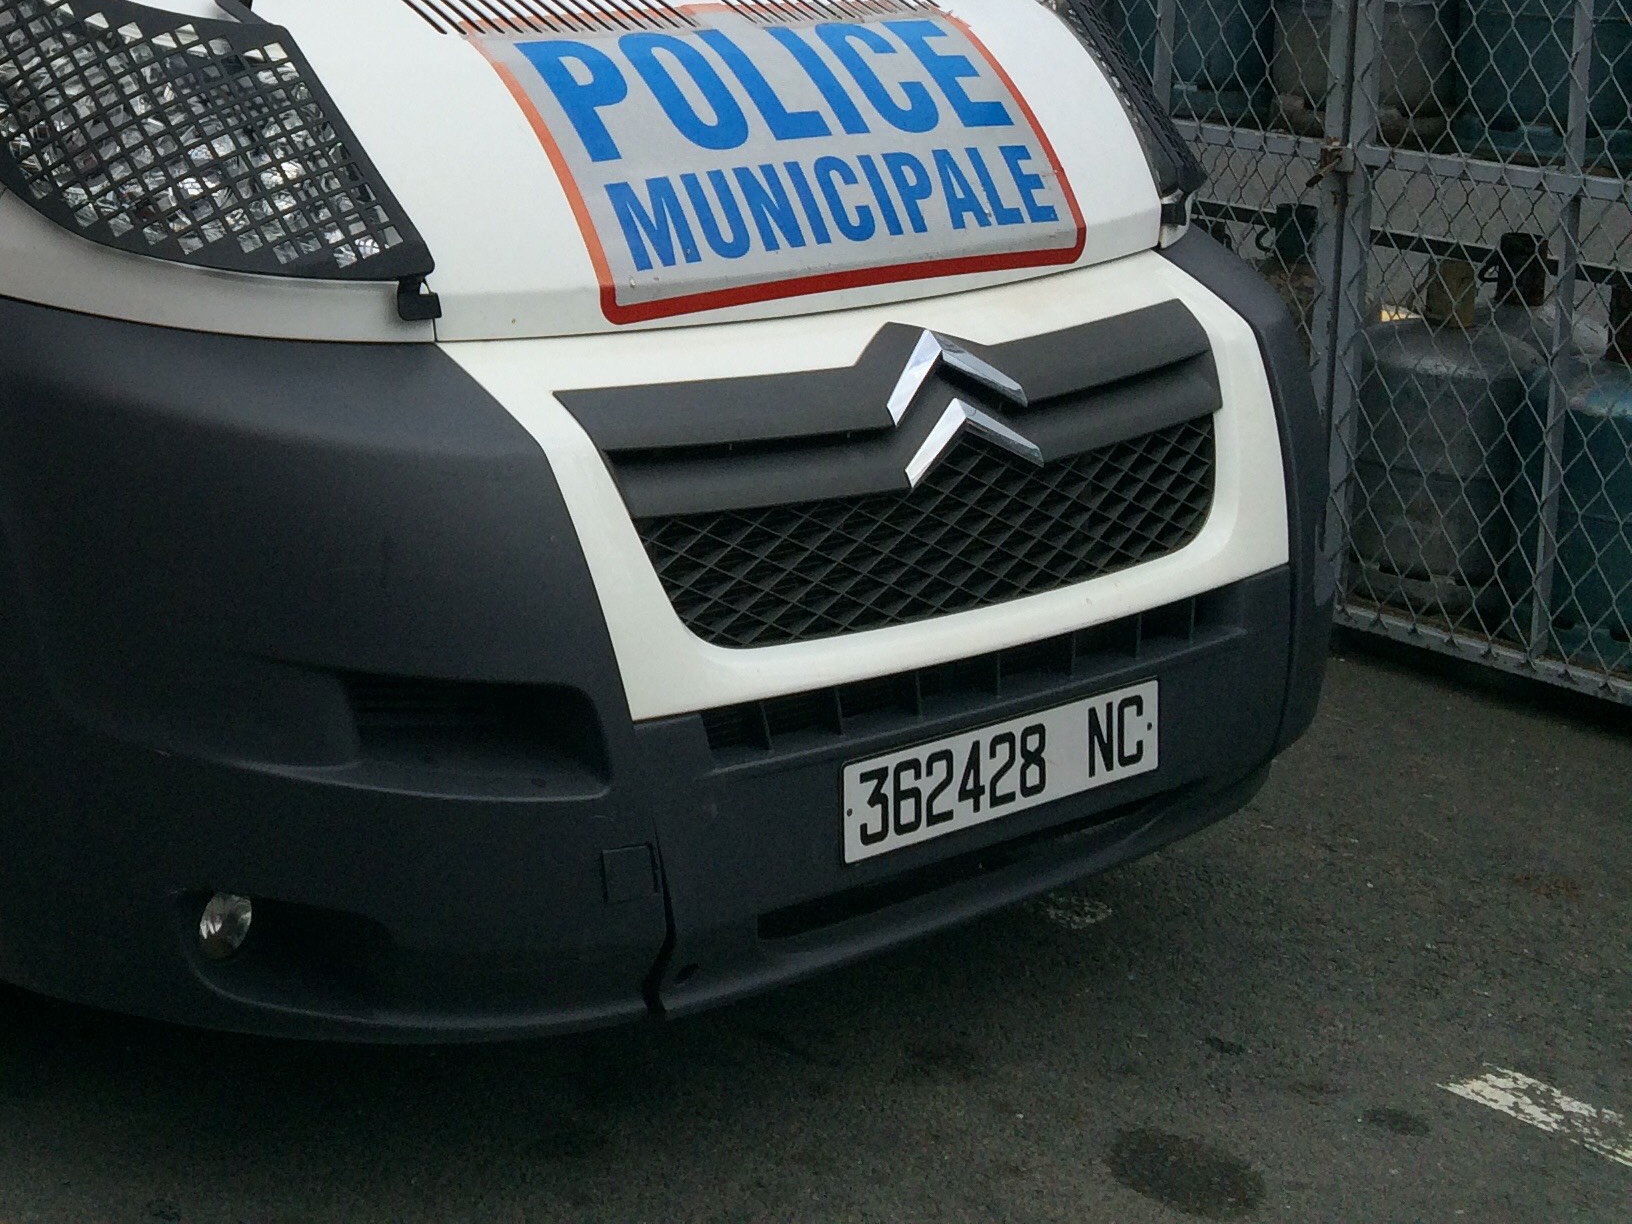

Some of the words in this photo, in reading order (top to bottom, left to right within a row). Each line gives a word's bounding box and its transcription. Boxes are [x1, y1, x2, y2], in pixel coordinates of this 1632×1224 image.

[513, 20, 1014, 163] POLICE
[604, 144, 1059, 273] MUNICIPALE
[859, 722, 1046, 846] 362428
[1087, 694, 1144, 778] NC
